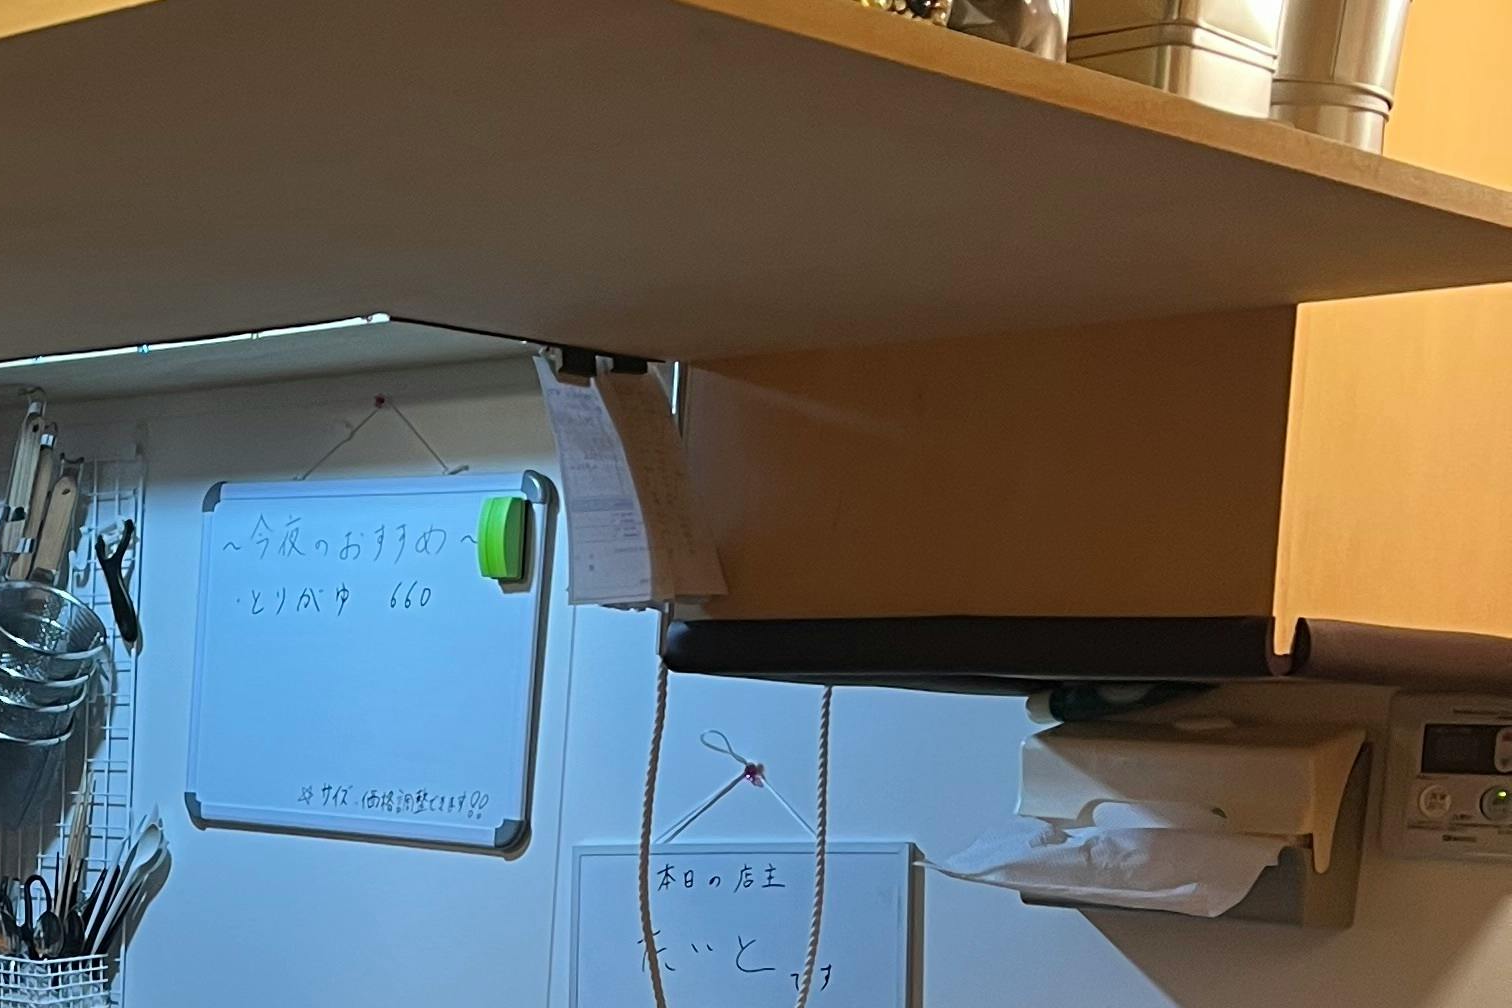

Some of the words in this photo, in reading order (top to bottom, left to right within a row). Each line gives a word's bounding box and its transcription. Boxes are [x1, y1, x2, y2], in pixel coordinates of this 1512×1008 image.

[390, 580, 432, 608] 660
[657, 863, 786, 894] 本日の店主
